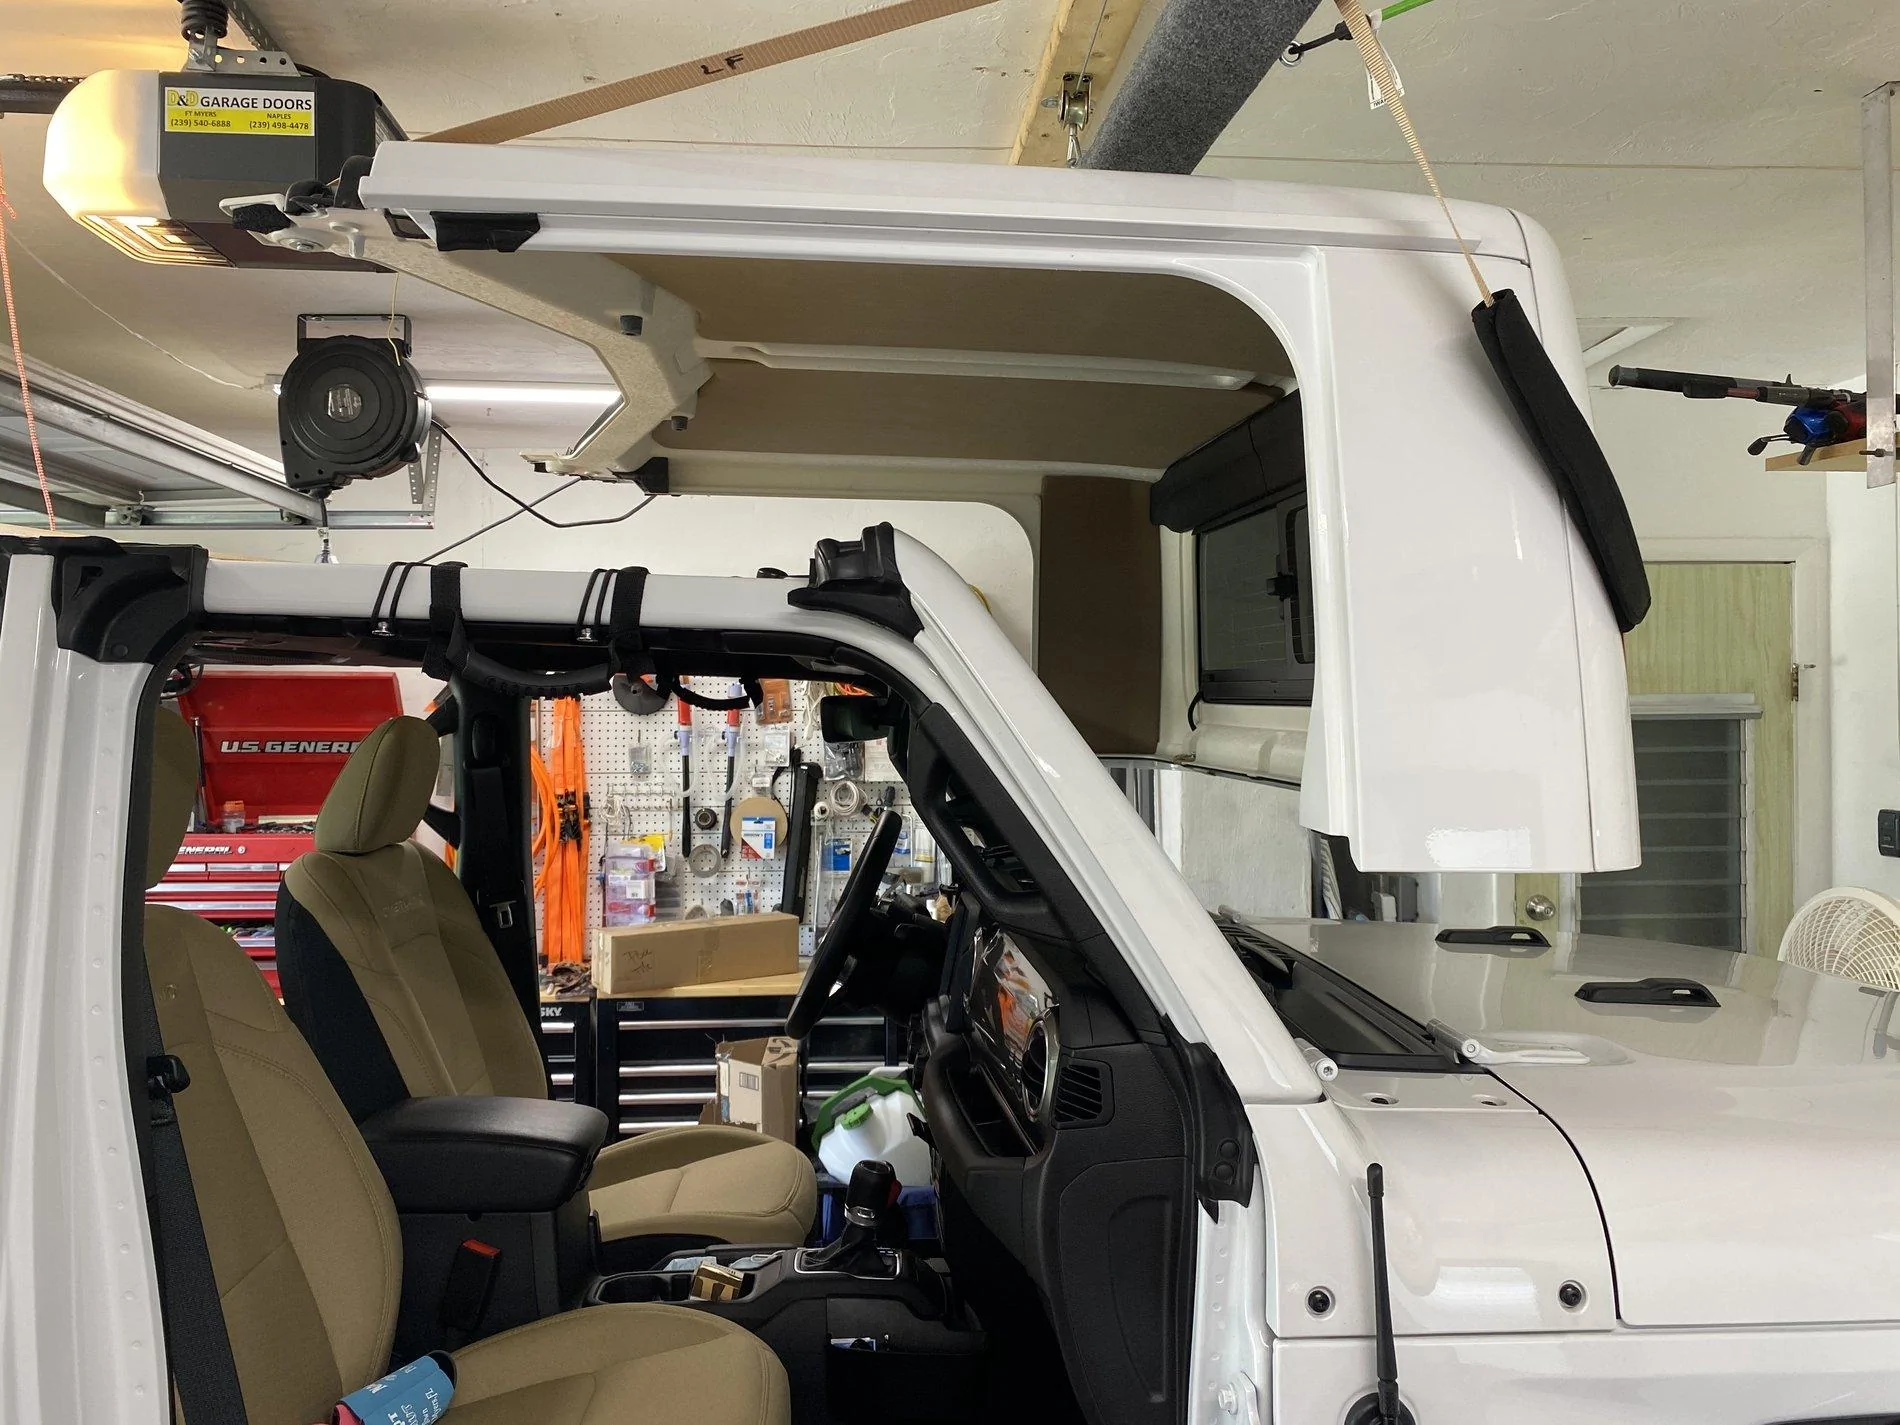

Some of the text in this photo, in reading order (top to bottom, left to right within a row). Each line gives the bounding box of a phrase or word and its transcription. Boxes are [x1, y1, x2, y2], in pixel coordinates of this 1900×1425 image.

[166, 89, 312, 110] D&D GARAGE DOORS
[170, 119, 231, 128] (239) 540-6888
[249, 121, 309, 130] (239) 498-4478
